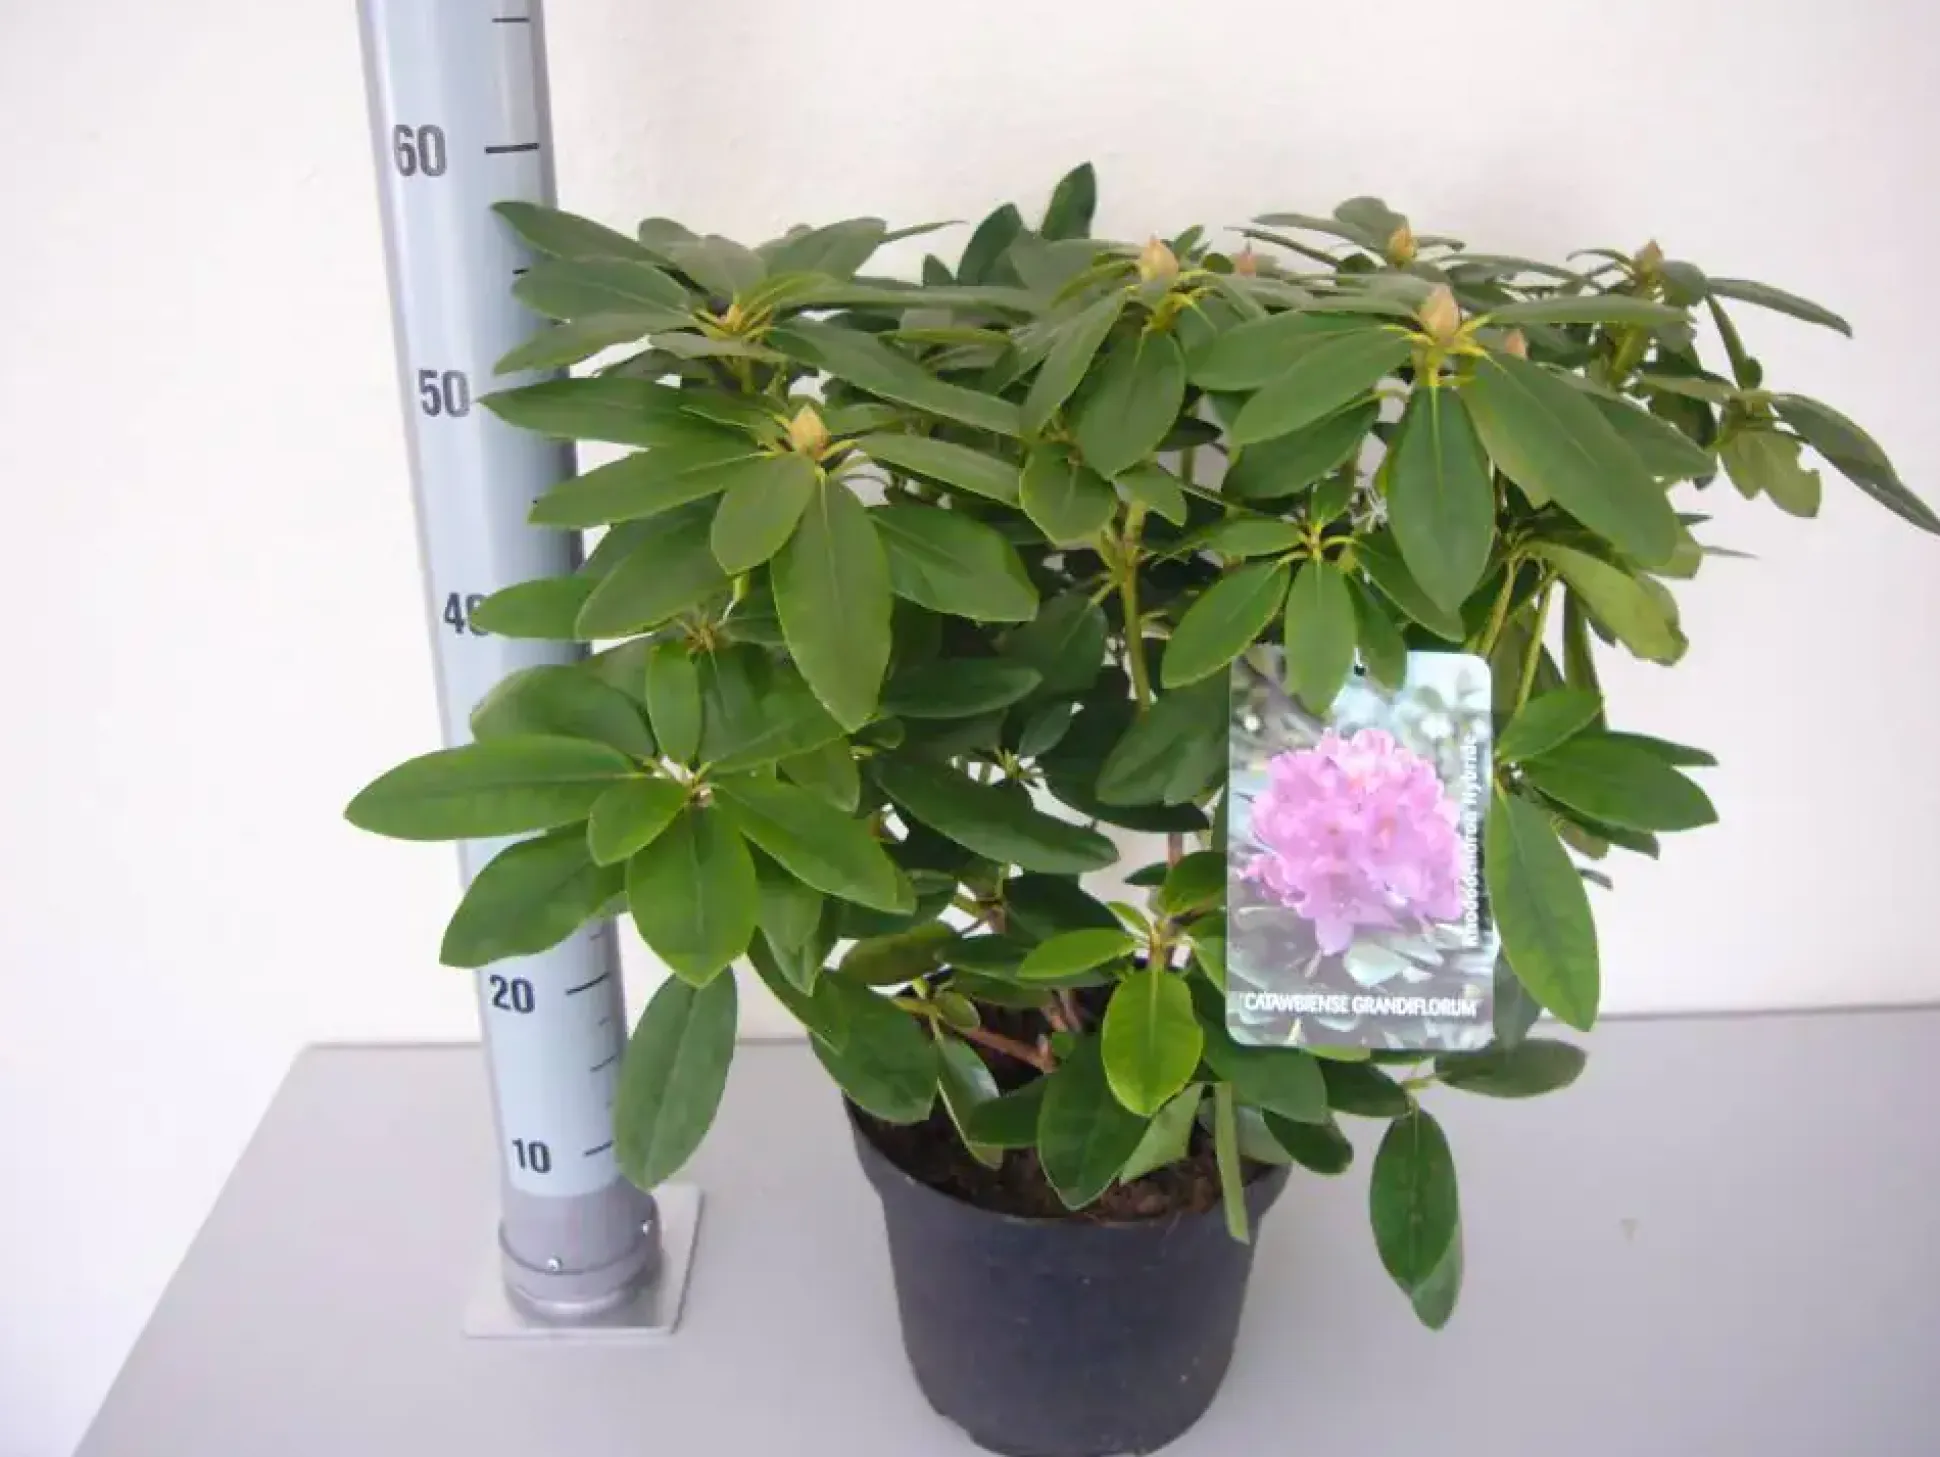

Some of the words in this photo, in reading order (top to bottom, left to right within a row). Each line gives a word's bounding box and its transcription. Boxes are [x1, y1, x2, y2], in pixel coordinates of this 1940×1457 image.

[393, 124, 447, 177] 60
[417, 369, 470, 418] 50
[489, 974, 535, 1014] 20
[511, 1138, 552, 1174] 10
